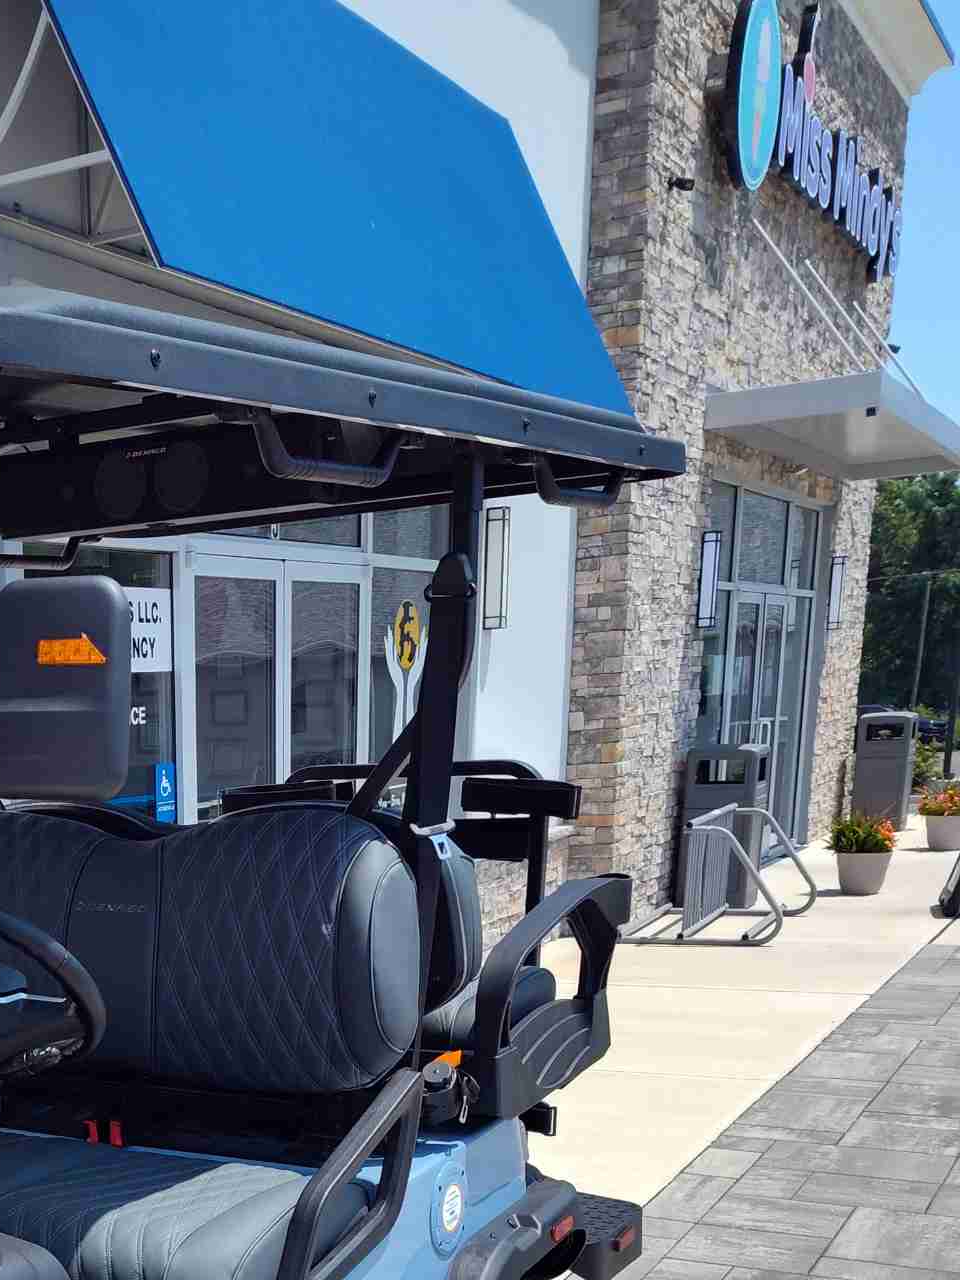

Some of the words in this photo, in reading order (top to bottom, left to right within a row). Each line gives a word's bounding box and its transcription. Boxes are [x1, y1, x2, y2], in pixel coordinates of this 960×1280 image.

[778, 54, 833, 209] Miss
[138, 601, 162, 624] LLC.
[129, 706, 147, 725] CE
